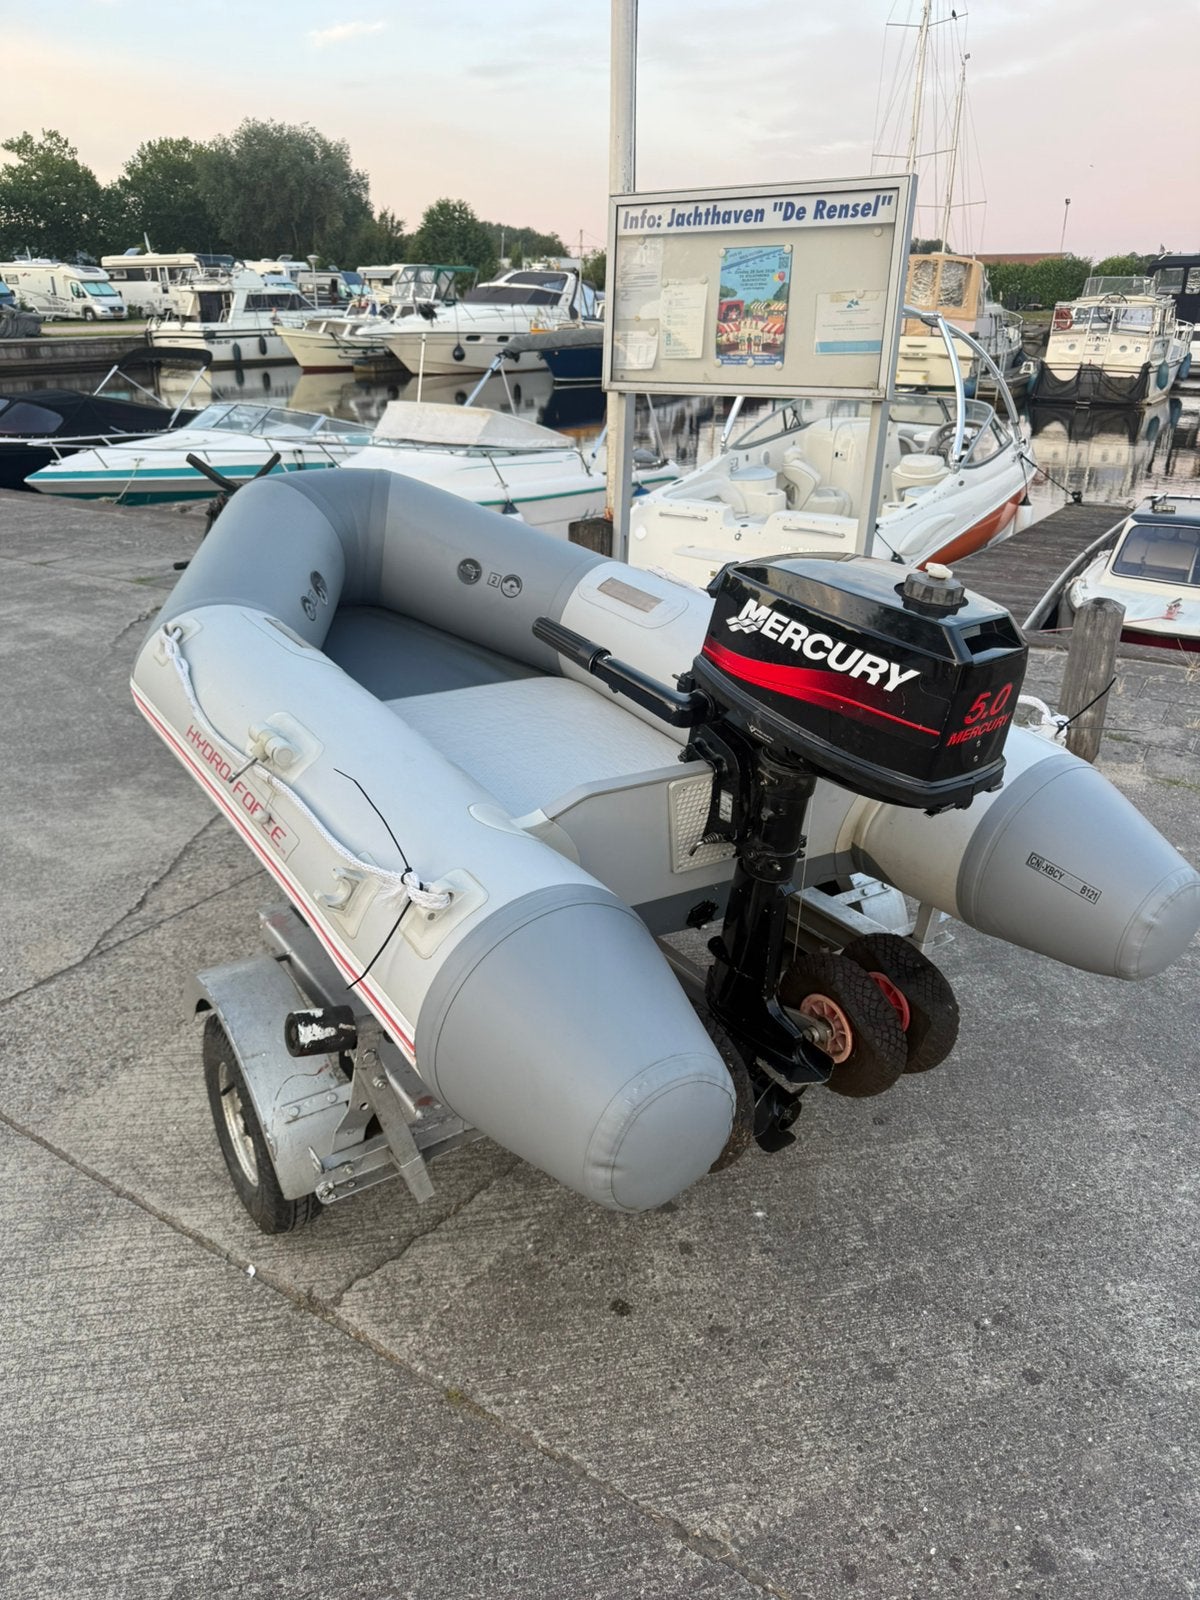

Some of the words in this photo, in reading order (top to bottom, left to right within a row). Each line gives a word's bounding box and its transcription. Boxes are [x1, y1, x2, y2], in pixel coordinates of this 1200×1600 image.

[623, 212, 662, 230] Info:
[667, 205, 765, 228] Jachthaven
[773, 199, 807, 221] "De
[813, 194, 893, 220] Rensel"
[727, 598, 920, 692] MERCURY
[965, 683, 1013, 723] 5.0
[946, 712, 1013, 746] MERCURY
[1030, 856, 1065, 880] CN-XBCY
[1080, 885, 1098, 900] B121
